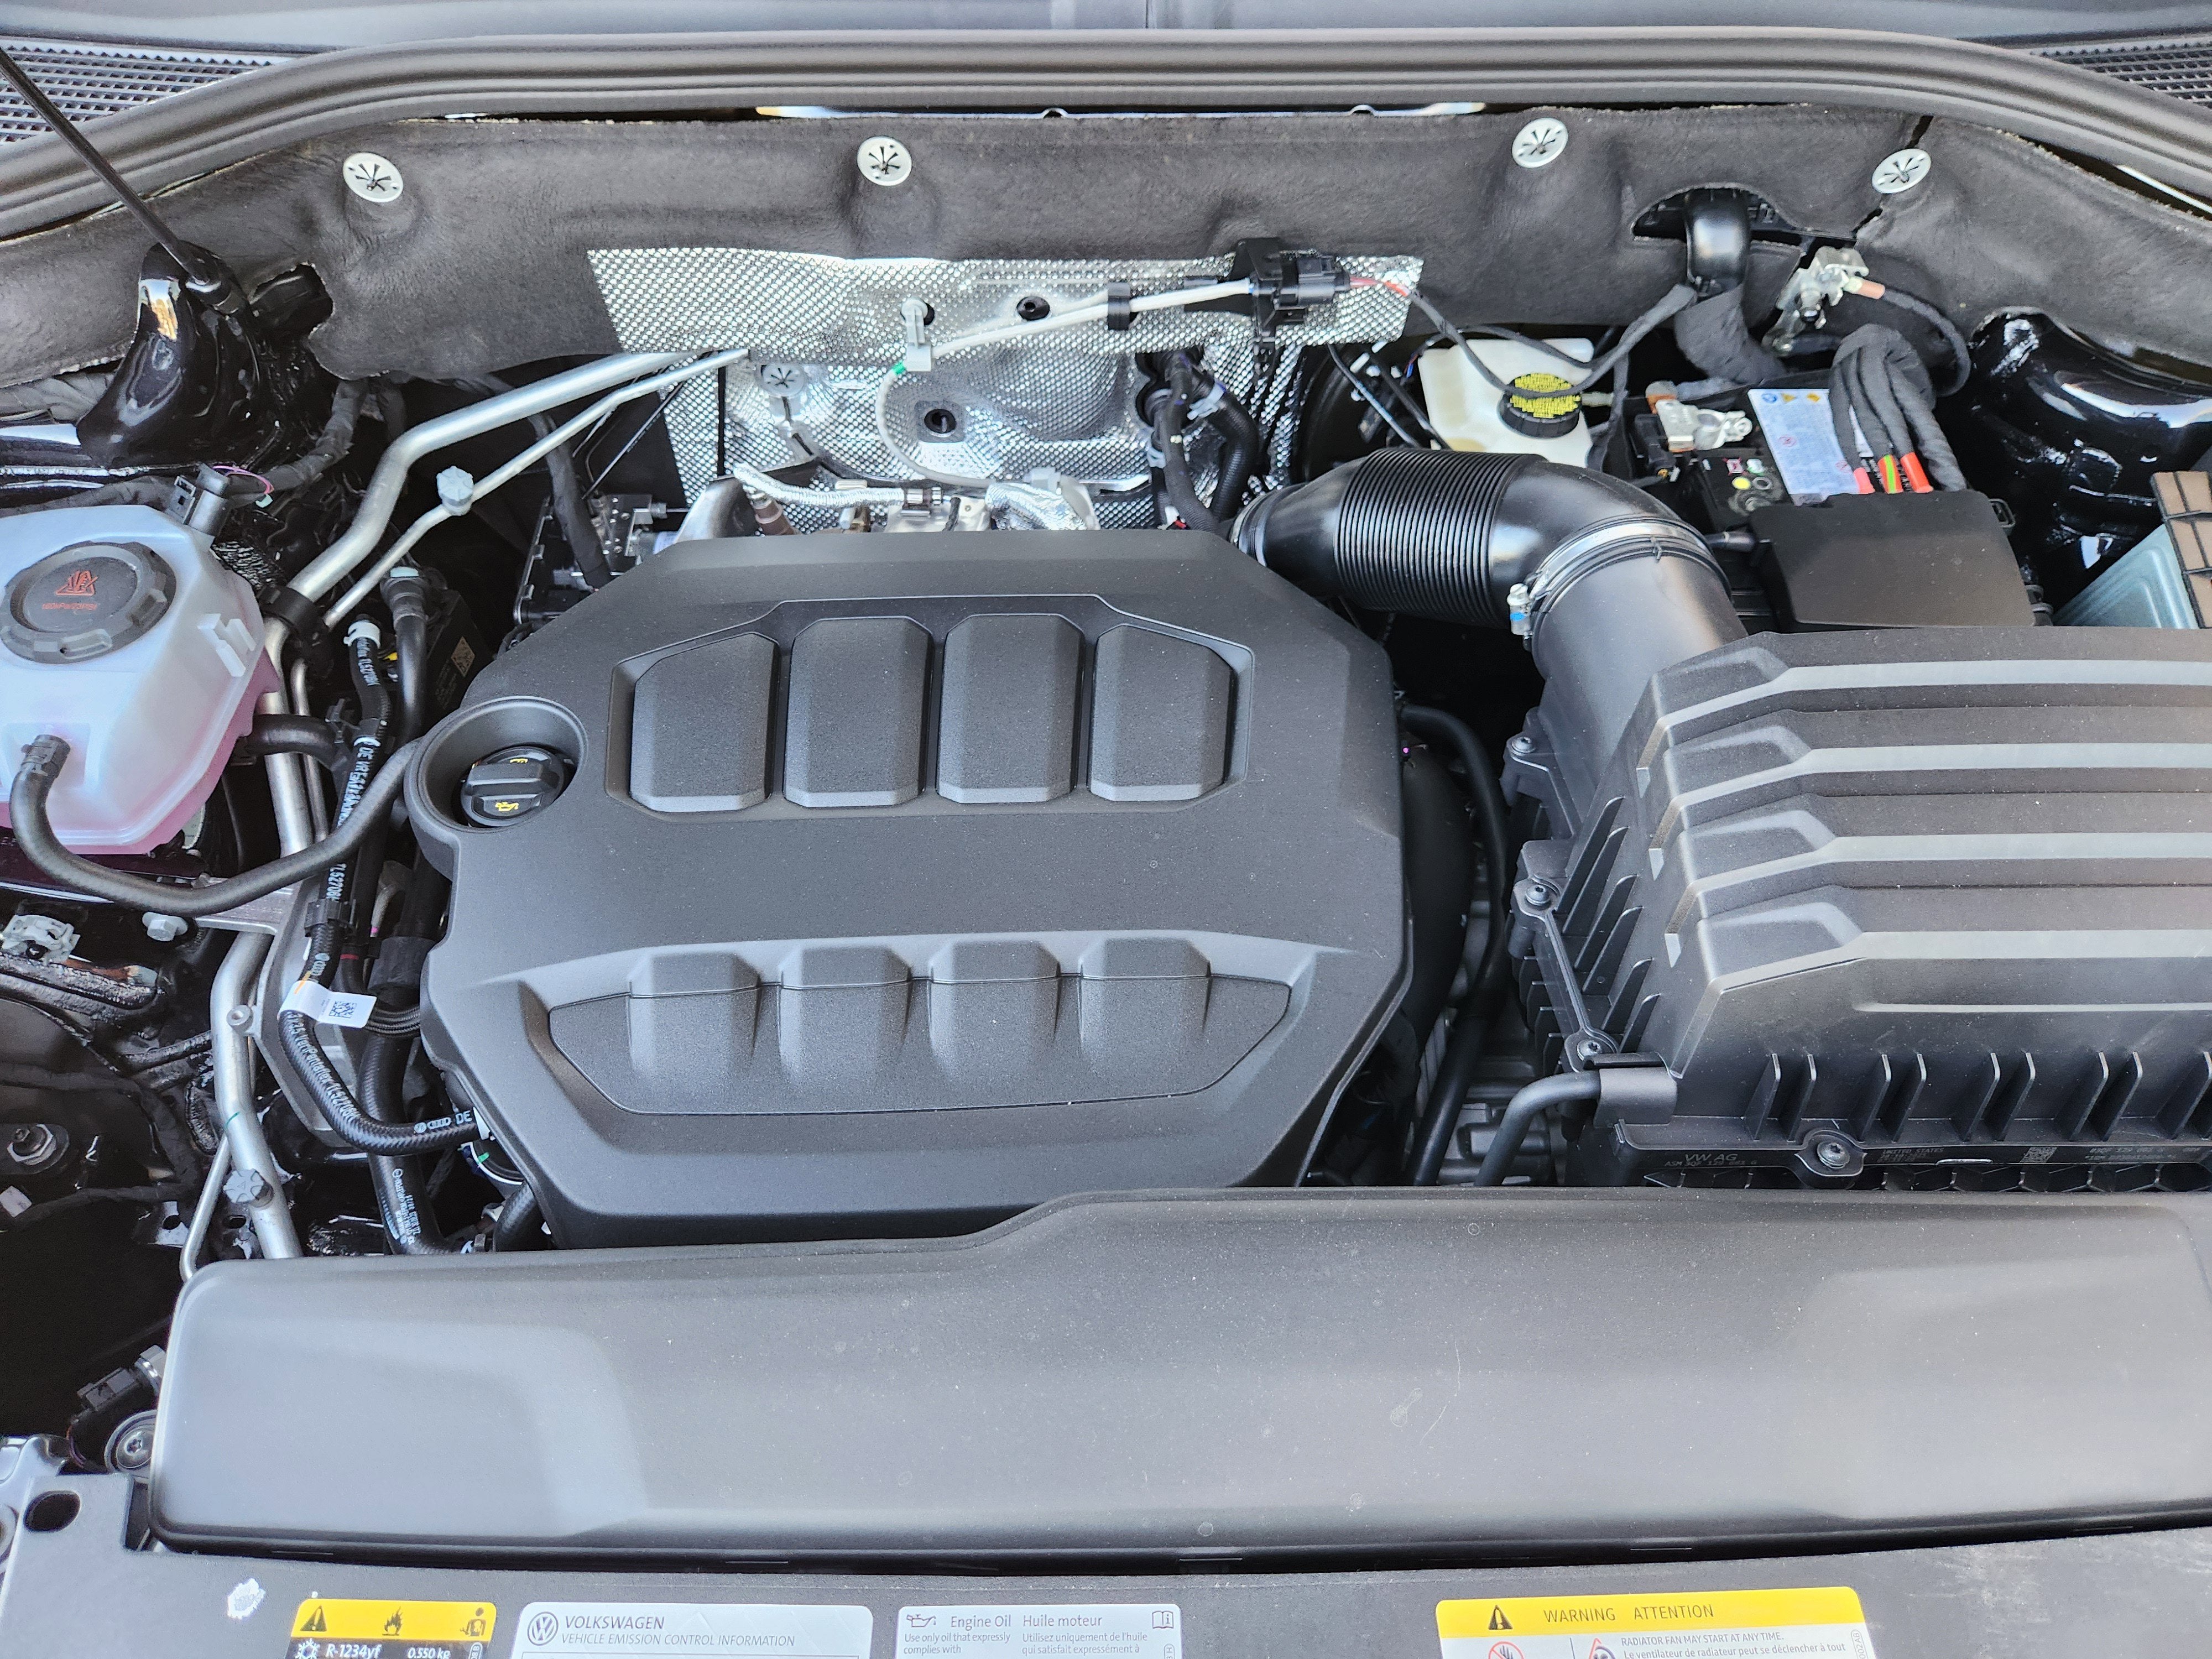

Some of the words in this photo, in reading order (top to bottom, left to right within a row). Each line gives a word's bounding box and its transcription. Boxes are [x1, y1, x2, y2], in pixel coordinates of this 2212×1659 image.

[455, 1110, 472, 1124] DE
[1023, 1614, 1055, 1627] Huile
[1057, 1615, 1103, 1626] moteur
[1543, 1607, 1616, 1623] WARNING
[1634, 1604, 1714, 1620] ATTENTION
[565, 1615, 665, 1630] VOLKSWAGEN
[951, 1615, 992, 1631] Engine
[995, 1614, 1011, 1627] Oil
[562, 1633, 605, 1645] VEHICLE
[608, 1634, 661, 1645] EMISSION
[664, 1634, 714, 1646] CONTROL
[718, 1635, 795, 1646] INFORMATION
[905, 1633, 920, 1642] Use
[922, 1632, 940, 1645] only
[941, 1632, 952, 1642] oil
[953, 1632, 971, 1642] that
[972, 1631, 1011, 1644] expressly
[1022, 1632, 1053, 1642] Utilisez
[1056, 1632, 1108, 1644] uniquement
[1109, 1632, 1120, 1641] de
[1121, 1631, 1148, 1641] l'huile
[1621, 1636, 1663, 1646] RADIATOR
[1665, 1635, 1682, 1645] FAN
[1683, 1635, 1701, 1644] MAY
[1703, 1634, 1729, 1643] START
[1731, 1633, 1740, 1642] AT
[1743, 1632, 1759, 1642] ANY
[1760, 1631, 1785, 1641] TIME.
[325, 1644, 383, 1659] R-1234yf
[408, 1647, 436, 1659] 0.550
[437, 1647, 451, 1659] kg
[904, 1645, 941, 1656] complies
[942, 1644, 962, 1654] with
[1022, 1645, 1036, 1656] qui
[1037, 1645, 1071, 1655] satisfait
[1073, 1644, 1133, 1656] expressément
[1134, 1644, 1140, 1654] à
[1624, 1650, 1635, 1659] Le
[1635, 1649, 1682, 1659] ventilateur
[1684, 1648, 1695, 1657] de
[1697, 1647, 1736, 1657] radiateur
[1738, 1646, 1759, 1657] peut
[1760, 1646, 1770, 1655] se
[1771, 1644, 1818, 1654] déclencher
[1820, 1642, 1826, 1652] à
[1827, 1642, 1846, 1652] tout
